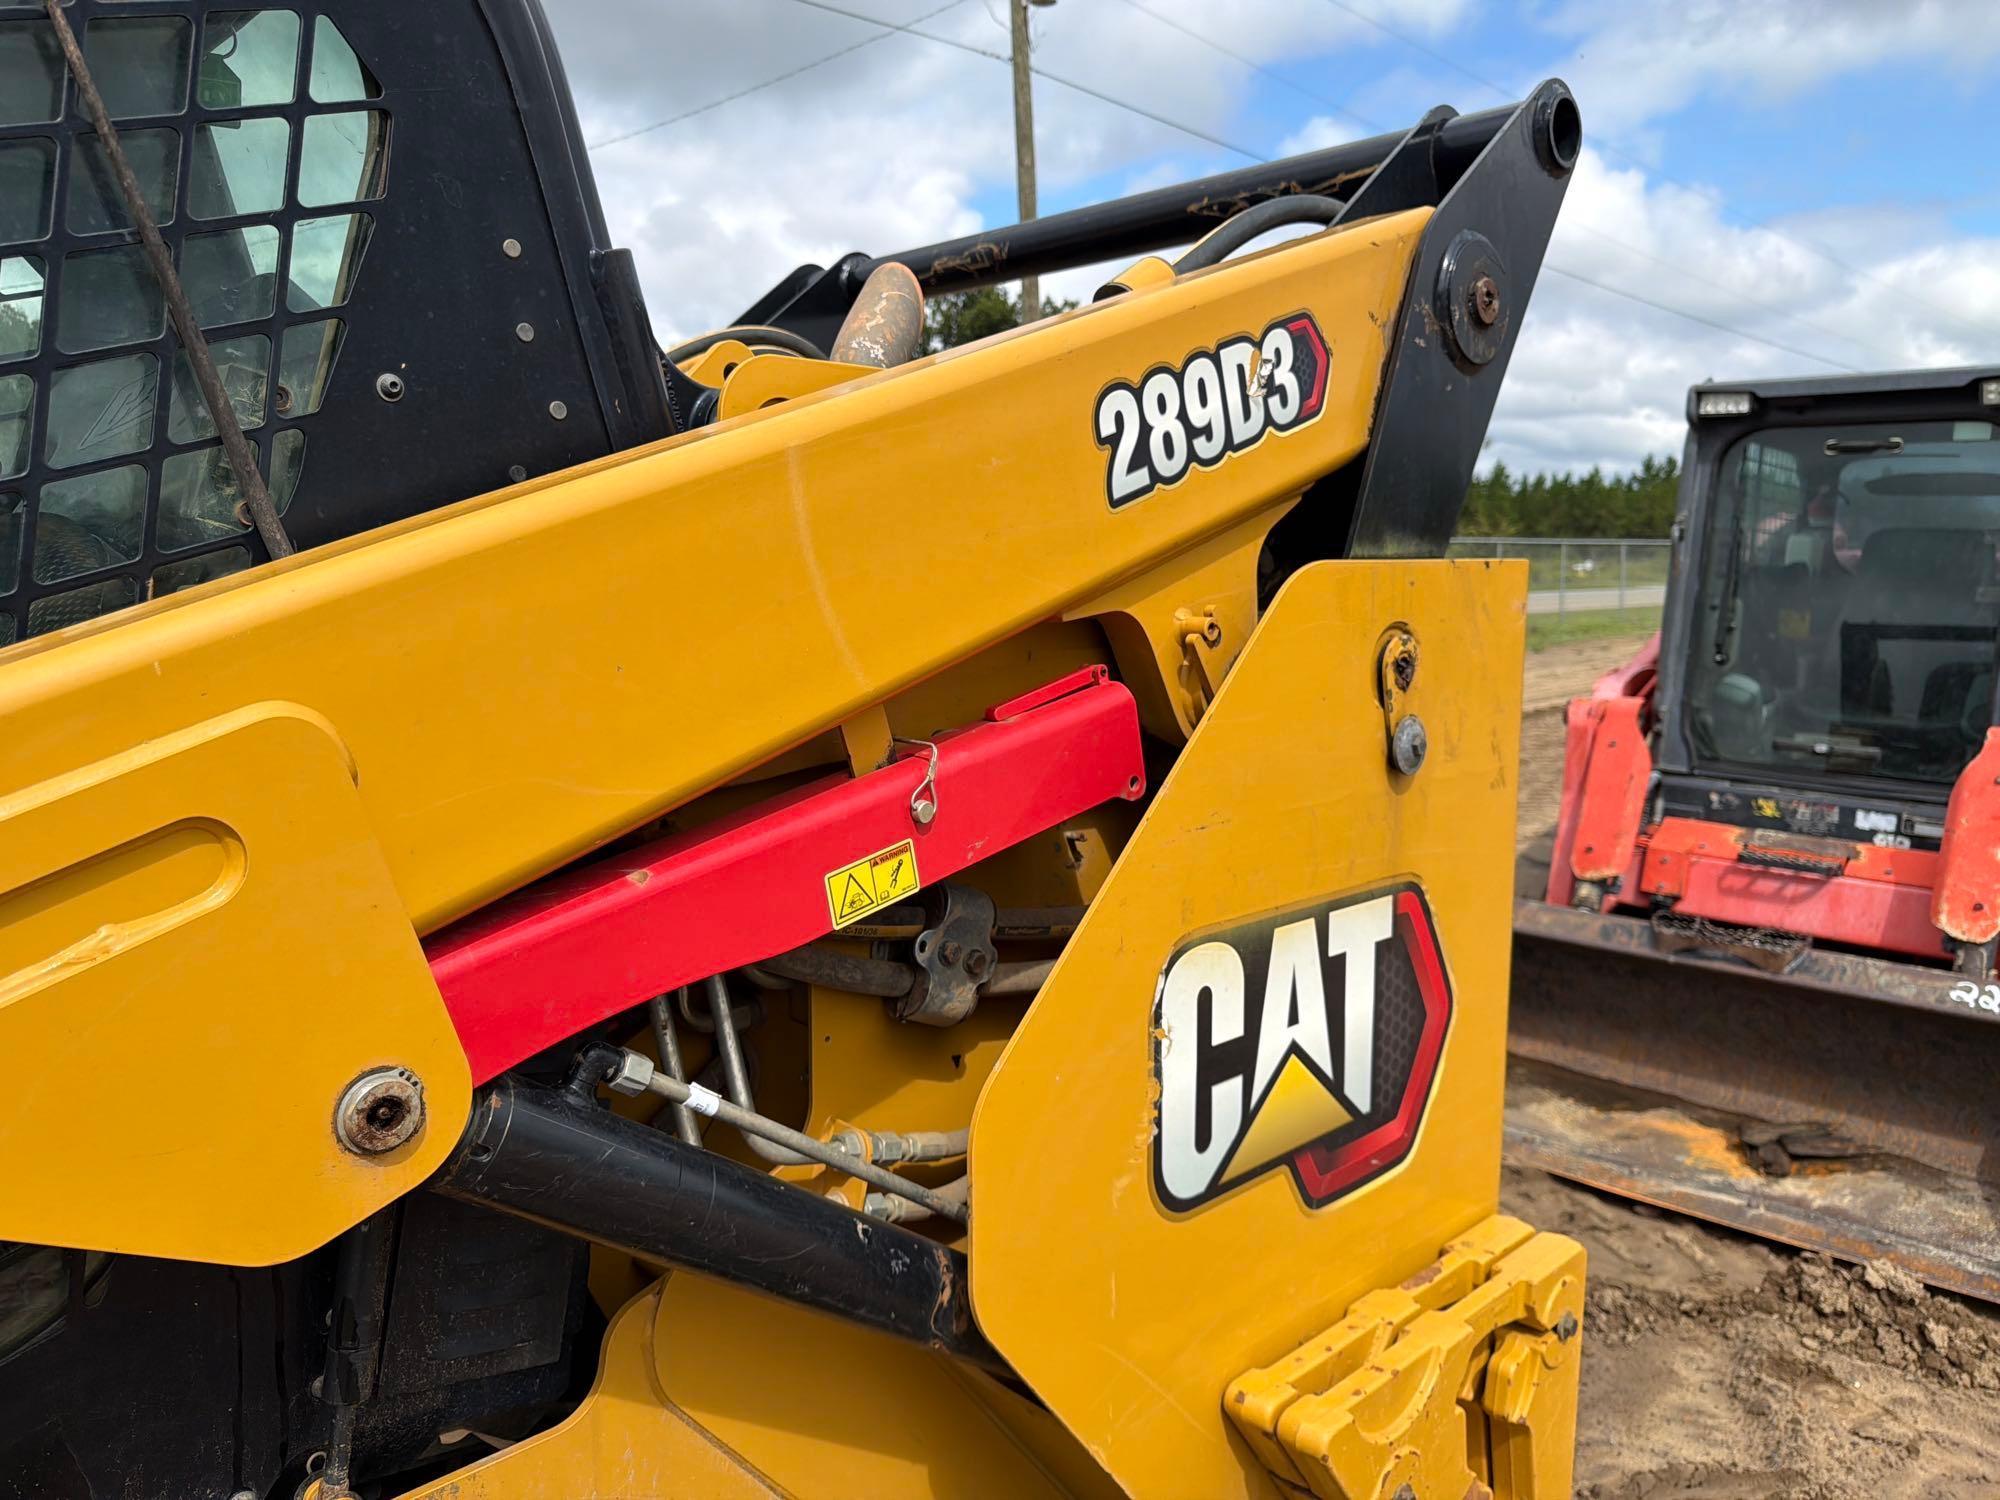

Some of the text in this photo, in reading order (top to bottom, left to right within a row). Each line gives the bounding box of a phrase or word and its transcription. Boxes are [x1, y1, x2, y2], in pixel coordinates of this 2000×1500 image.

[1099, 327, 1300, 501] 289D3
[879, 845, 909, 864] WARNING
[1161, 894, 1393, 1200] CAT
